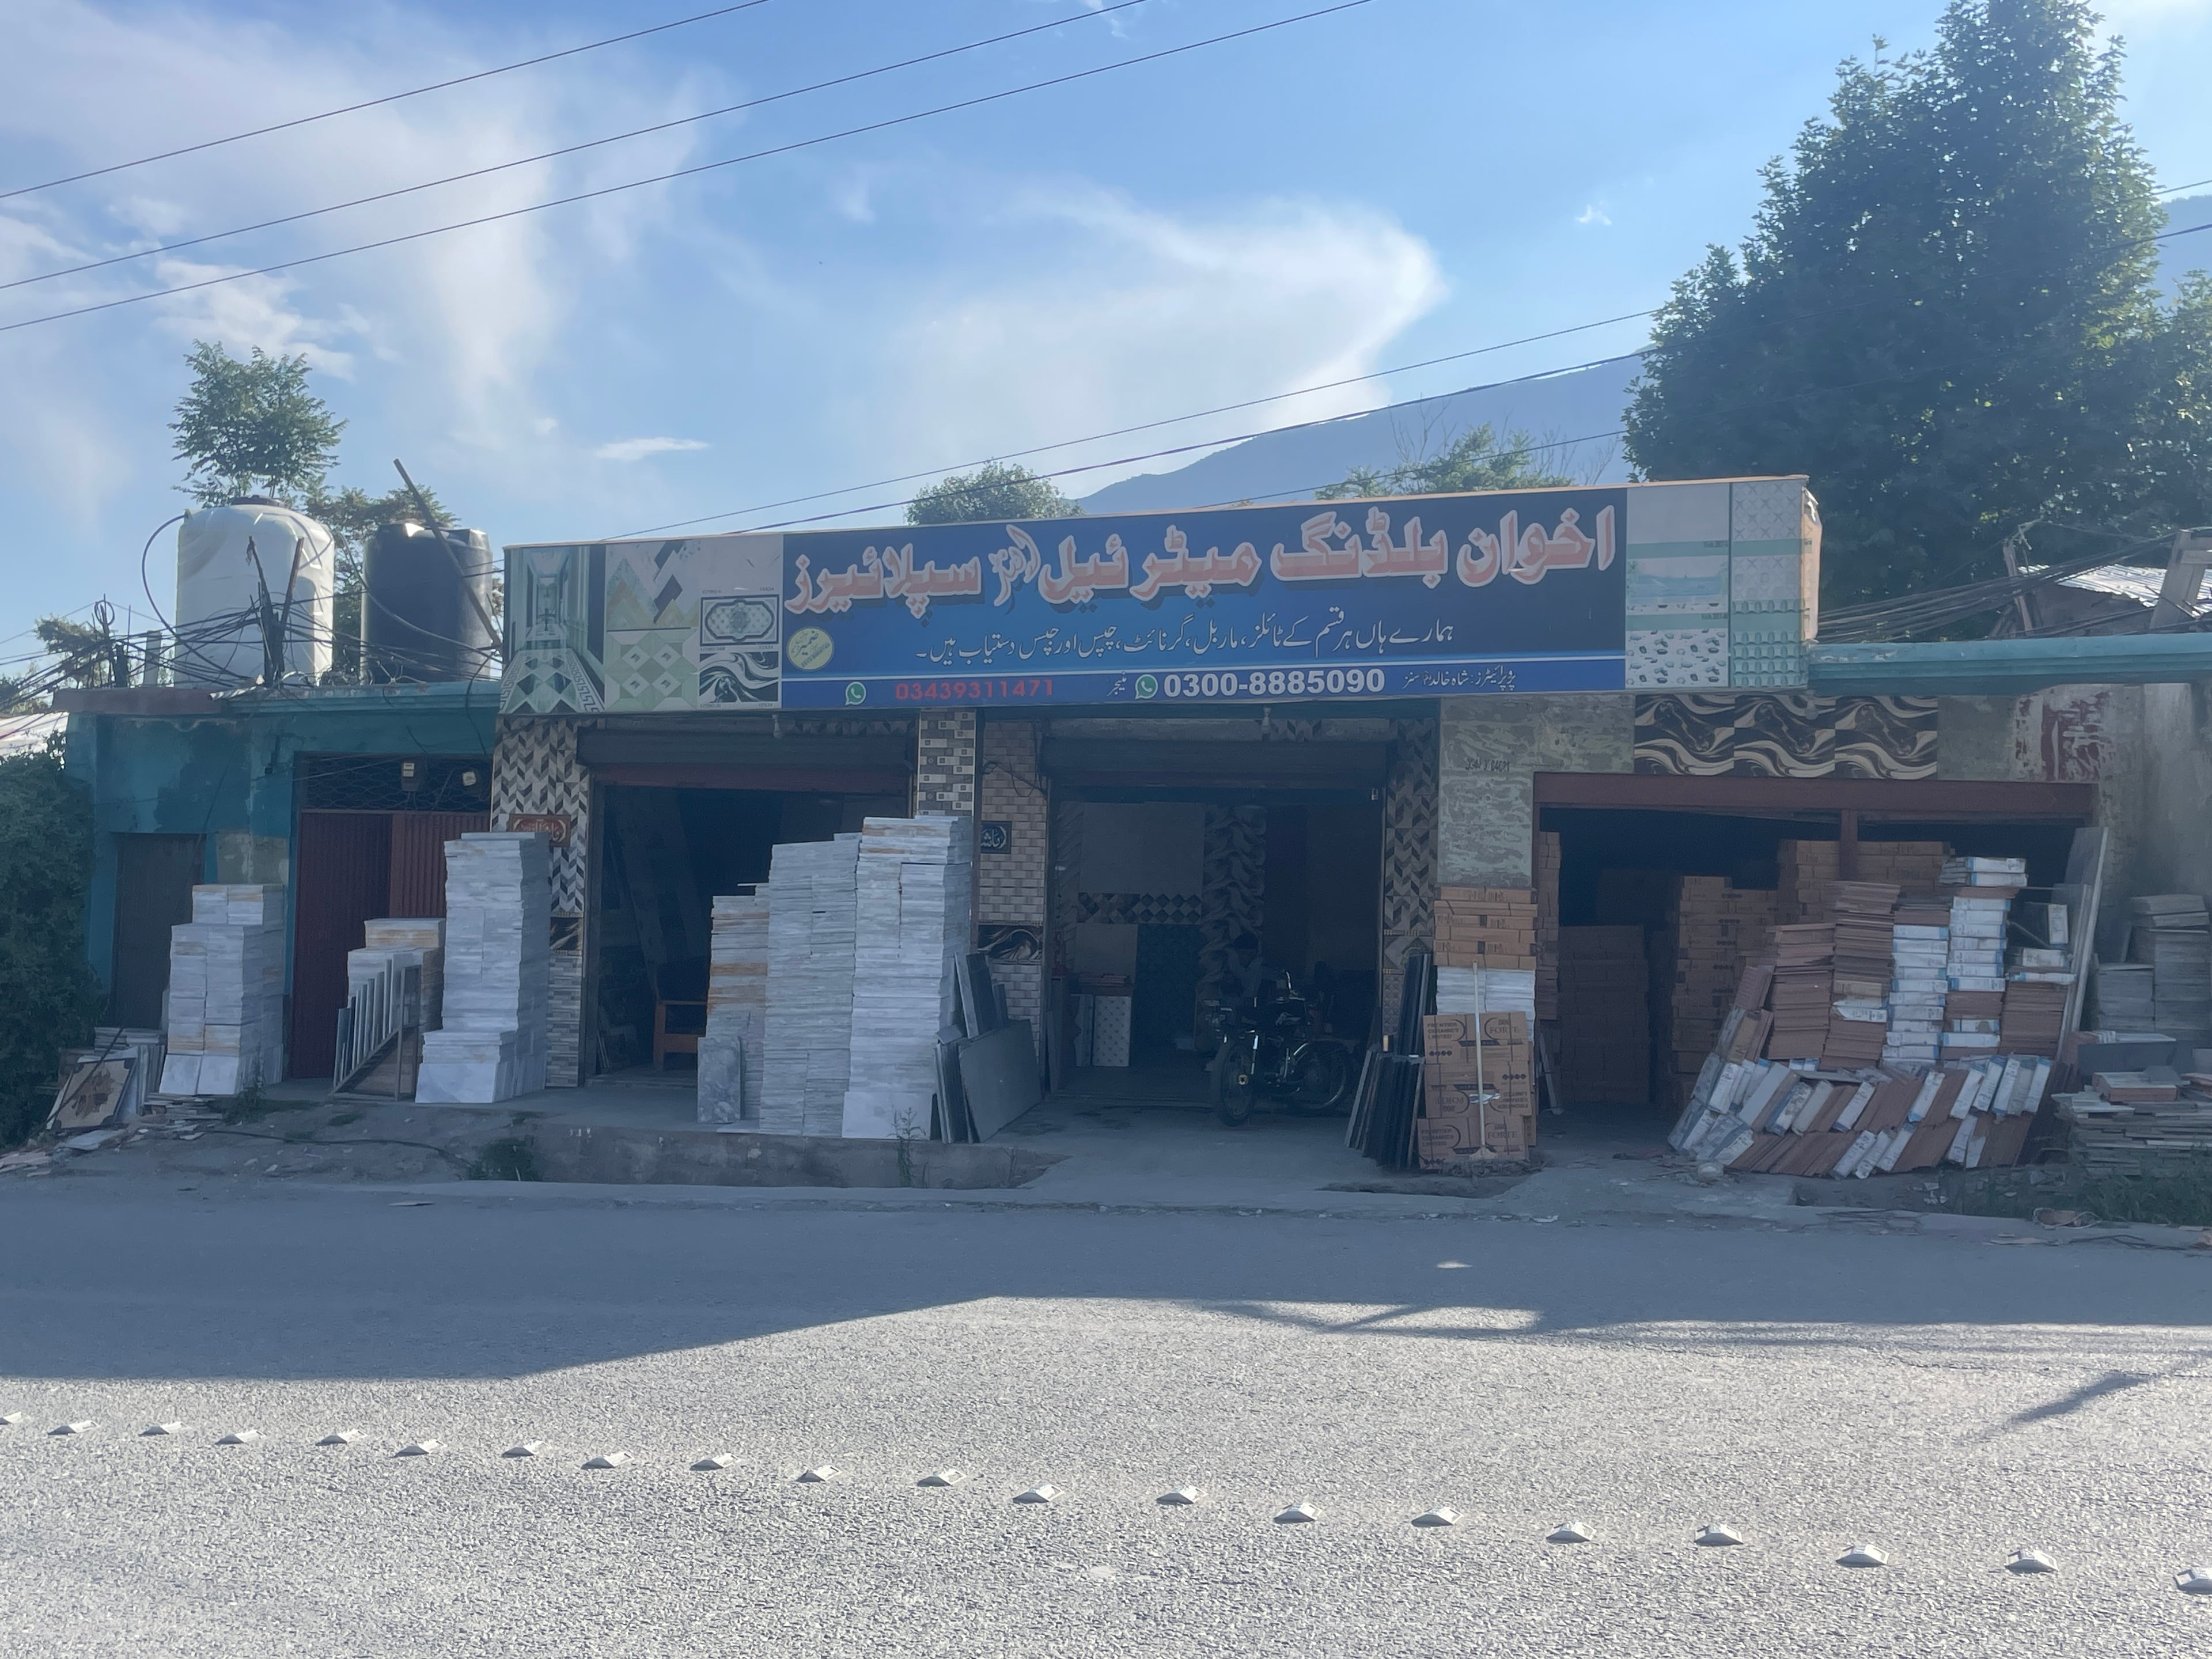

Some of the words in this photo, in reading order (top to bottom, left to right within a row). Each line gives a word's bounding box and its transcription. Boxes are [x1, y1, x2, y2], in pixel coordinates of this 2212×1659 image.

[1270, 506, 1449, 589] بلڈنگ
[1457, 505, 1616, 588] اخوان
[1053, 632, 1077, 654] اور
[1078, 625, 1118, 658] چپس
[1282, 614, 1313, 647] کے
[1315, 607, 1345, 659] قسم
[1332, 630, 1353, 652] ہر
[1355, 619, 1387, 654] ہاں
[1388, 619, 1454, 645] ہمارے
[958, 631, 1014, 665] دستیاب
[895, 679, 1053, 701] 03439311471
[1164, 668, 1385, 698] 0300-8885090
[1401, 671, 1420, 690] سنز
[1428, 670, 1450, 687] خالد
[1451, 669, 1469, 686] شاہ
[1489, 1026, 1520, 1035] FORTE
